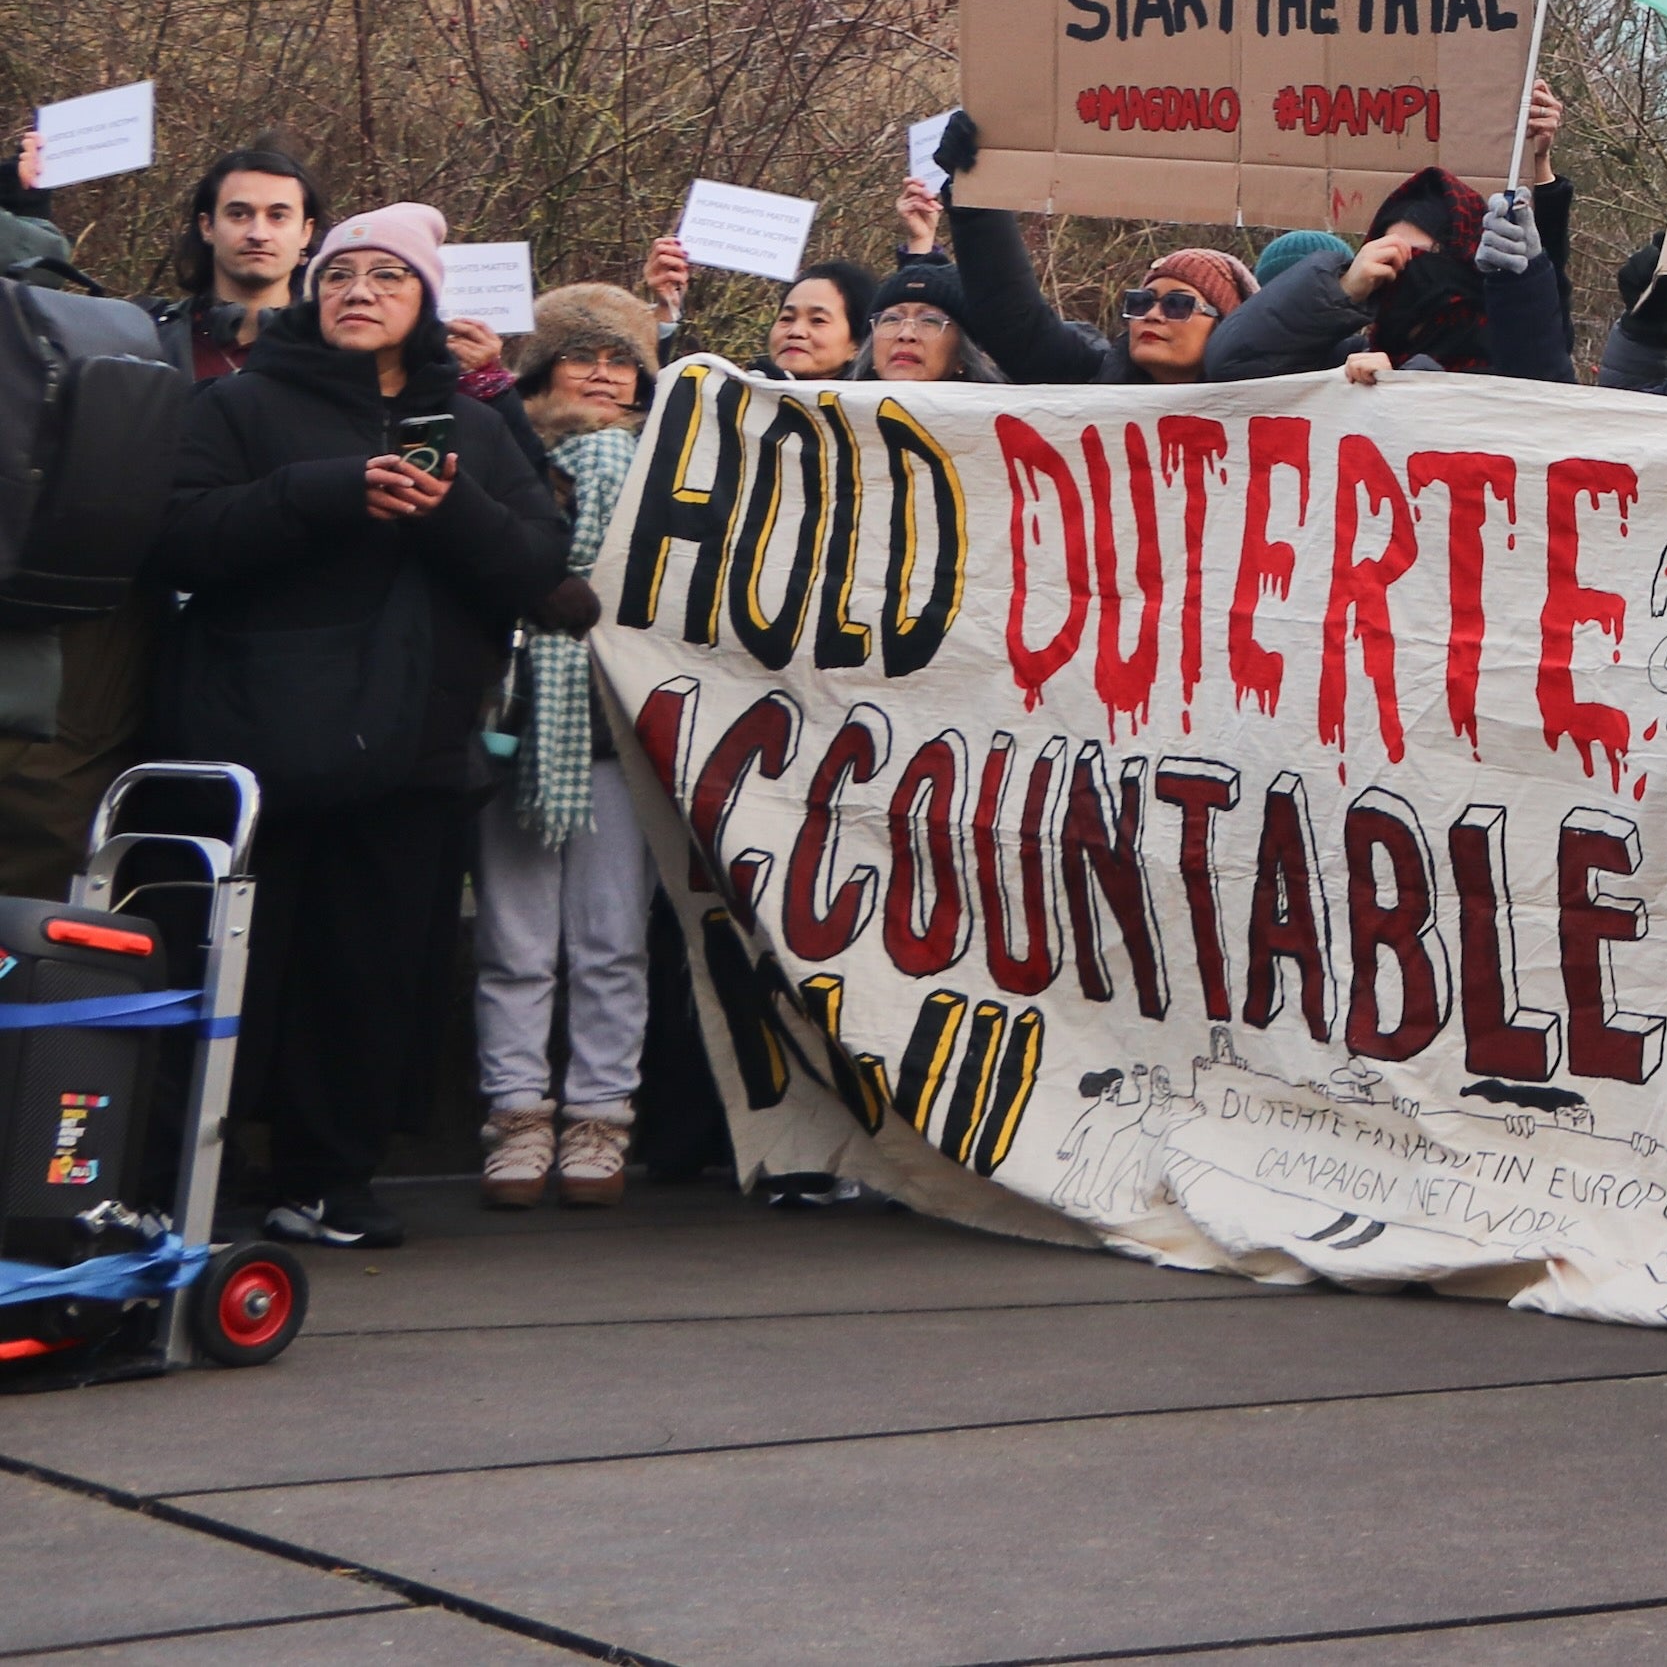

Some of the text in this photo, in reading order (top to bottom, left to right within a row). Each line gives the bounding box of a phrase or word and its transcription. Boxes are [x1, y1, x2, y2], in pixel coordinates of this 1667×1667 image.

[1076, 84, 1441, 141] #MAGDALO #DAMPI
[616, 364, 1640, 794] HOLD DUTERTE
[1256, 1146, 1397, 1203] CAMPAIGN
